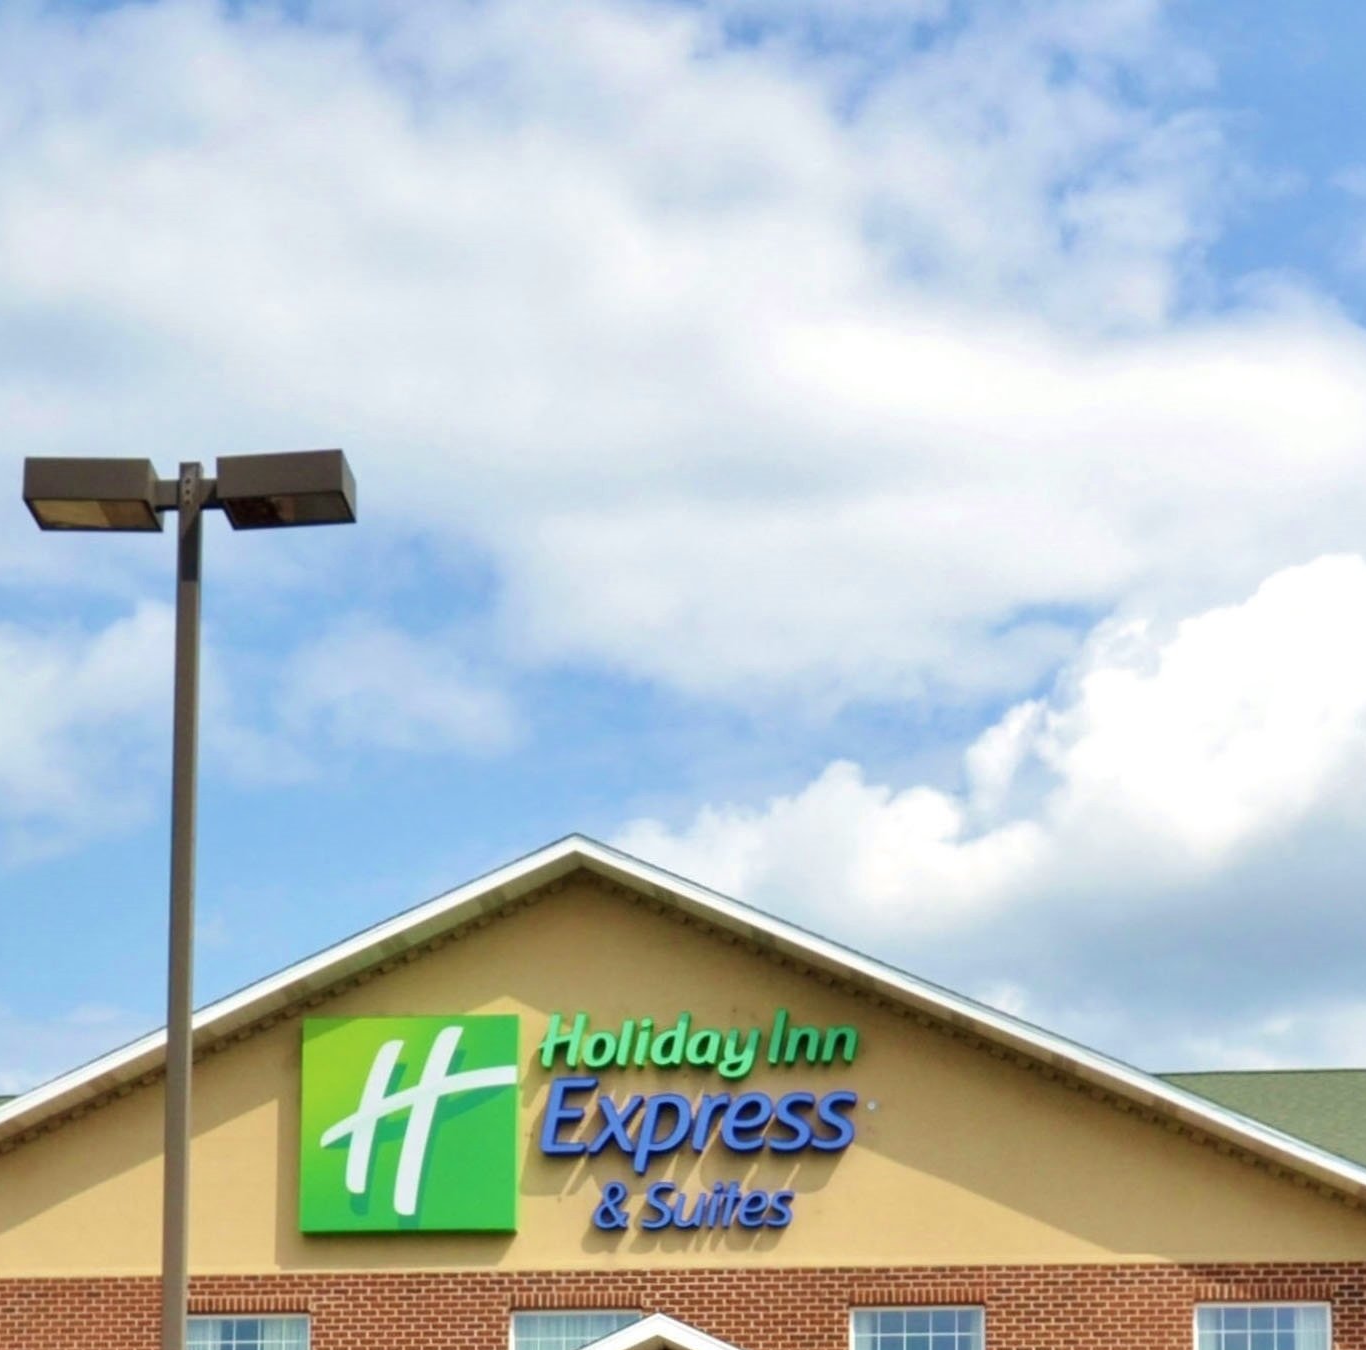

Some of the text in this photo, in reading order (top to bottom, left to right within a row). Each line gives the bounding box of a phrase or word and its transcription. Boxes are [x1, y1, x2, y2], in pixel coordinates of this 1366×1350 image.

[538, 1008, 858, 1080] Holiday Inn
[538, 1076, 859, 1175] Express
[593, 1180, 795, 1229] & Suites
